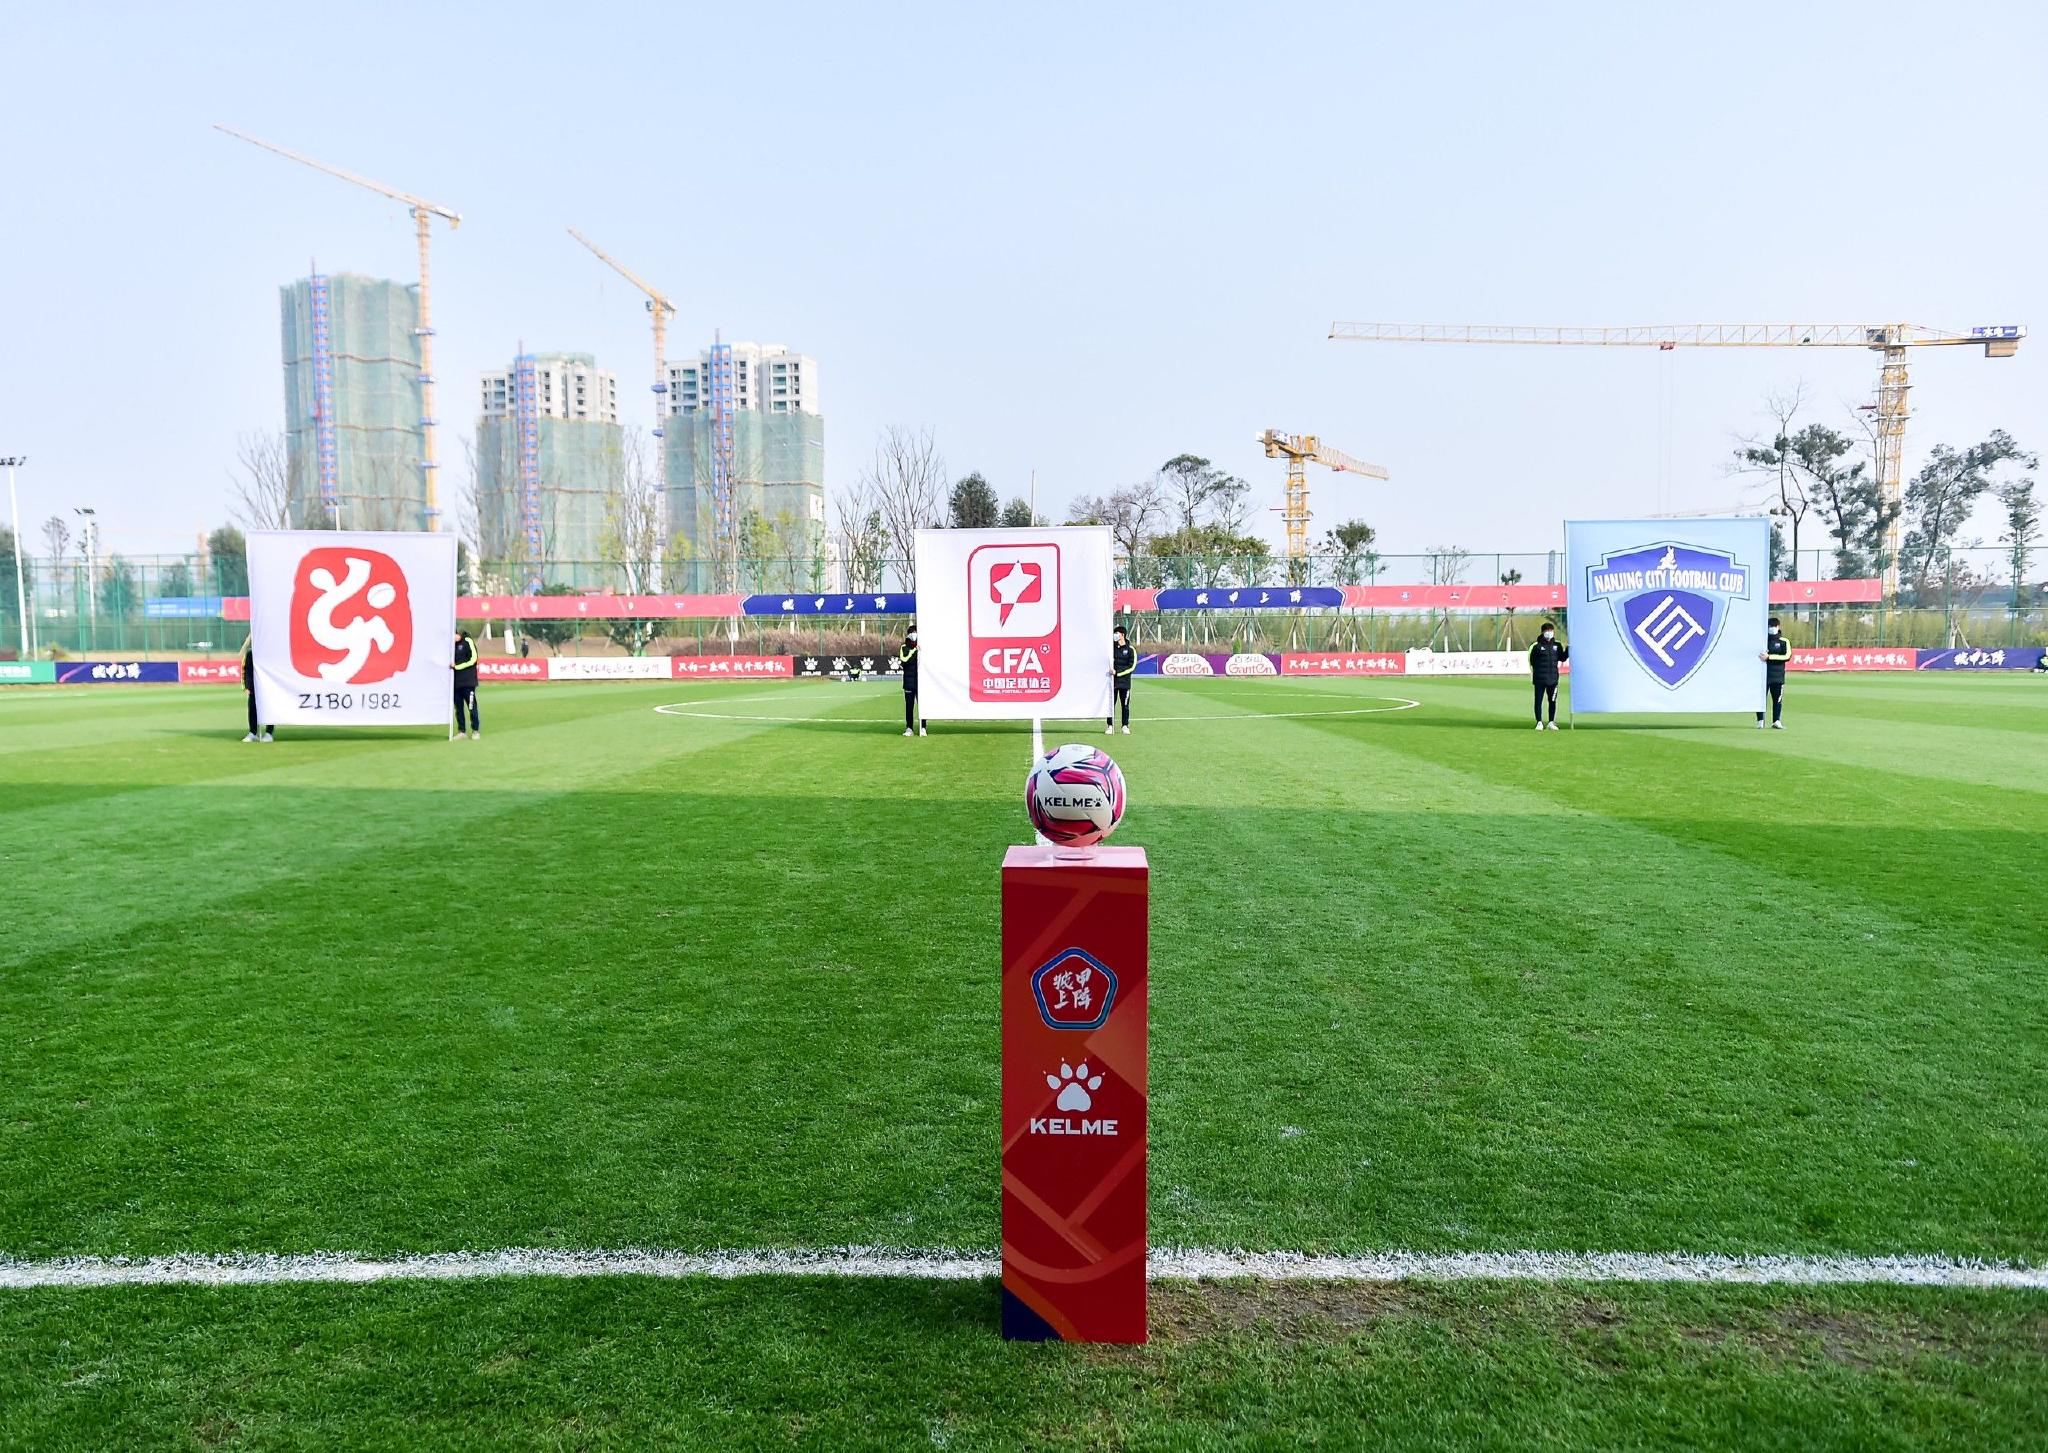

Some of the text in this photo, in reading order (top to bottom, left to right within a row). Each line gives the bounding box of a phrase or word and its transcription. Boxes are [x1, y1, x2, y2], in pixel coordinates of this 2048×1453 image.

[1594, 569, 1744, 593] NANJING CITY FOOTBALL CLUB
[982, 647, 1044, 674] CFA
[983, 677, 1050, 689] 中国足球协会
[299, 693, 402, 709] ZIBO 1982
[1044, 797, 1092, 807] KELME
[1030, 1118, 1118, 1136] KELME
